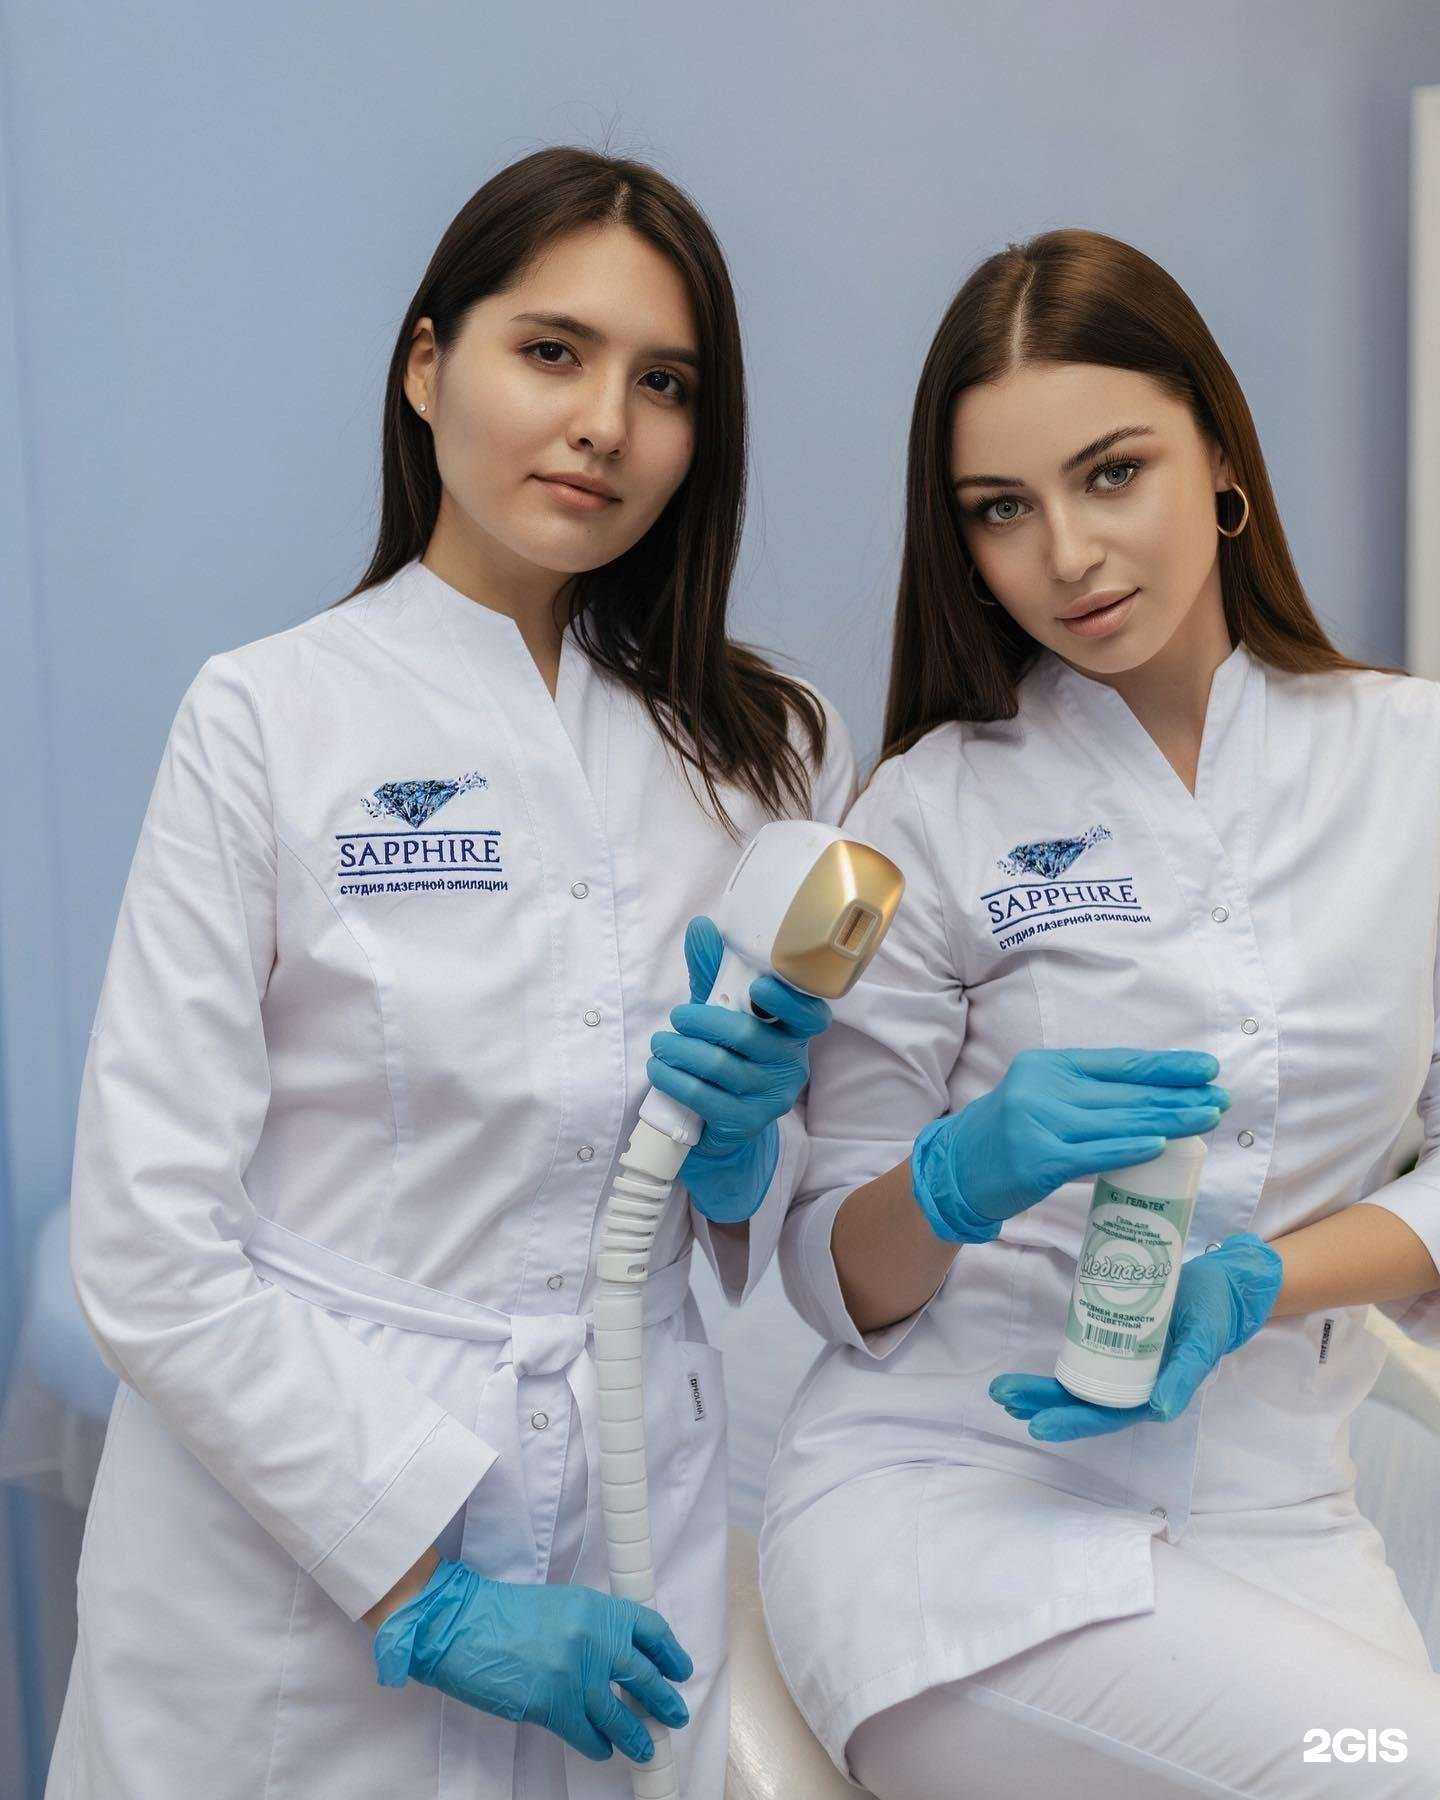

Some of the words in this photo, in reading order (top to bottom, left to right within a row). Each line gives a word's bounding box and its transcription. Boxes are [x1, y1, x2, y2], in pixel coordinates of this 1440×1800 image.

[340, 839, 500, 868] SAPPHIRE
[340, 882, 385, 896] СТУДИЯ
[386, 878, 445, 892] ЛАЗЕРНОЙ
[446, 880, 508, 892] ЭПИЛЯЦИИ
[987, 885, 1138, 924] SAPPHIRE
[999, 926, 1036, 951] СТУДИЯ
[1036, 912, 1093, 933] ЛАЗЕРНОЙ
[1094, 912, 1151, 923] ЭПИЛЯЦИИ
[1126, 1196, 1165, 1212] ГЕЛЬТЕК
[1081, 1253, 1172, 1281] Медиагель
[1087, 1310, 1142, 1329] БЕСЦВЕТНЫЙ
[1113, 1312, 1155, 1323] ВЯЗКОСТИ
